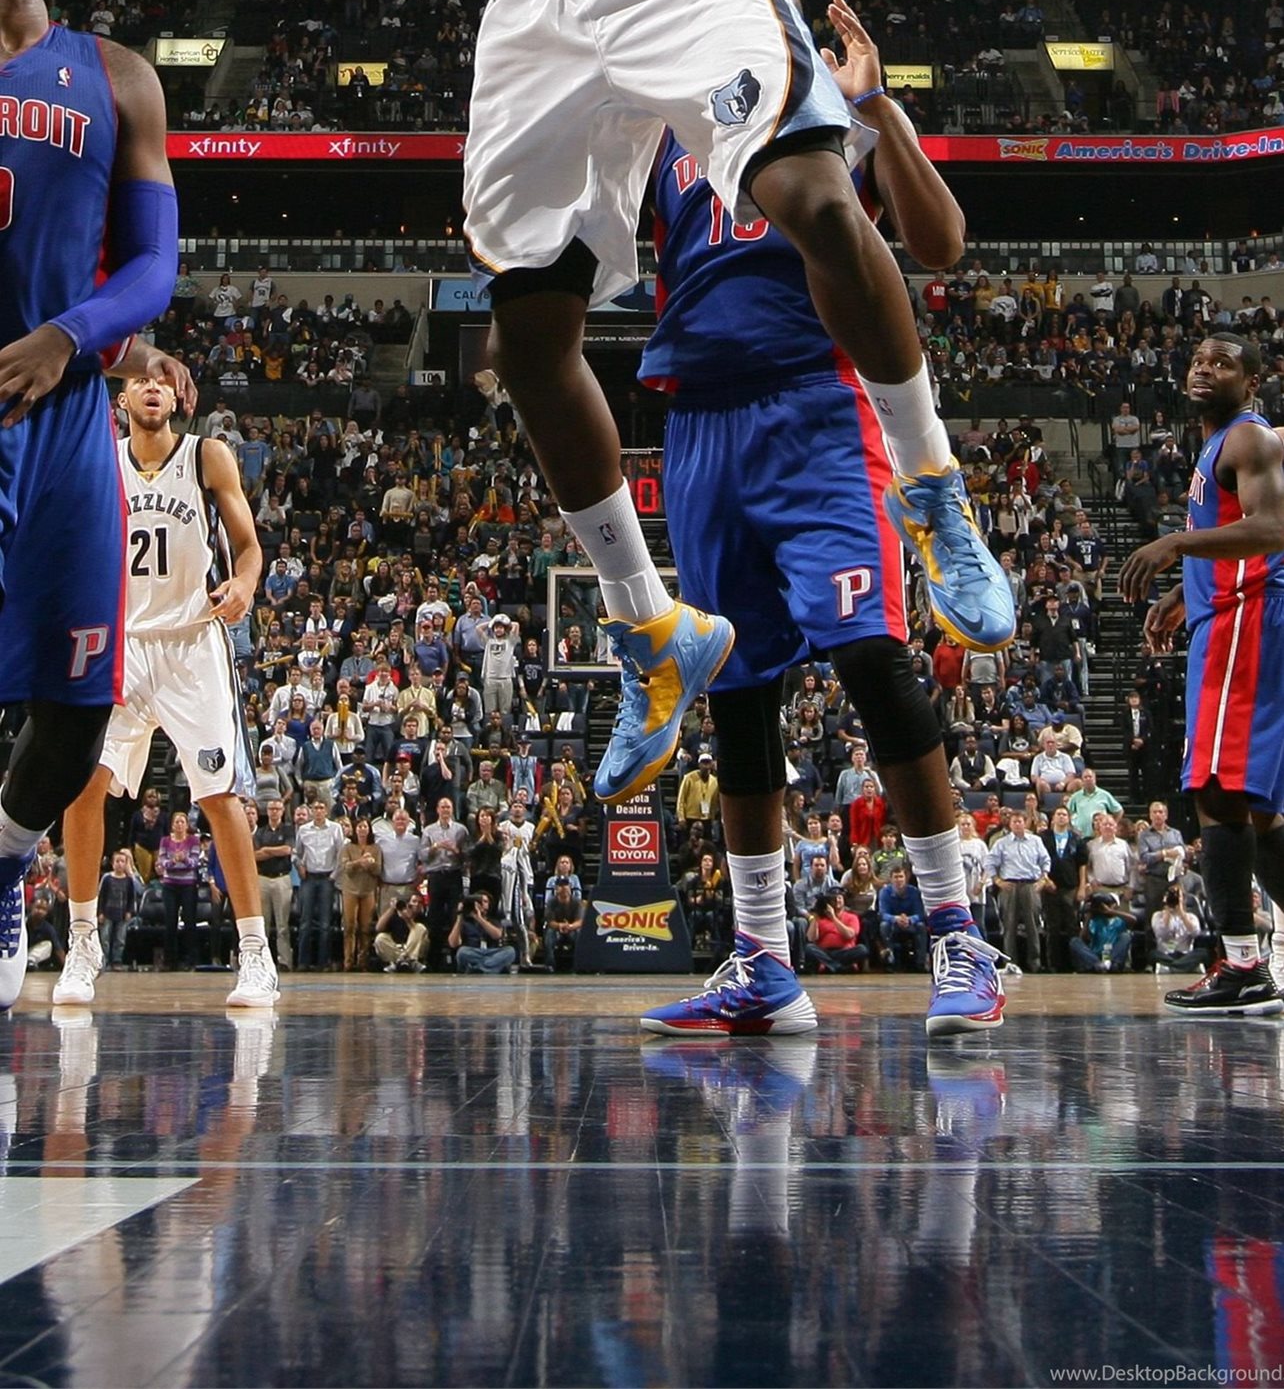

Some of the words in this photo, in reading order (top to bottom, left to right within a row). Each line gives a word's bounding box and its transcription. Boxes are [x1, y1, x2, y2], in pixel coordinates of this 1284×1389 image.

[188, 137, 262, 157] xfinity
[328, 137, 401, 157] xfinity
[1002, 144, 1045, 155] SONIC
[1055, 139, 1173, 160] America's
[130, 527, 168, 577] 21
[832, 567, 873, 619] P
[69, 624, 109, 680] P
[616, 805, 652, 814] Dealers
[611, 850, 656, 859] TOYOTA
[601, 912, 669, 929] SONIC
[606, 935, 646, 943] America's
